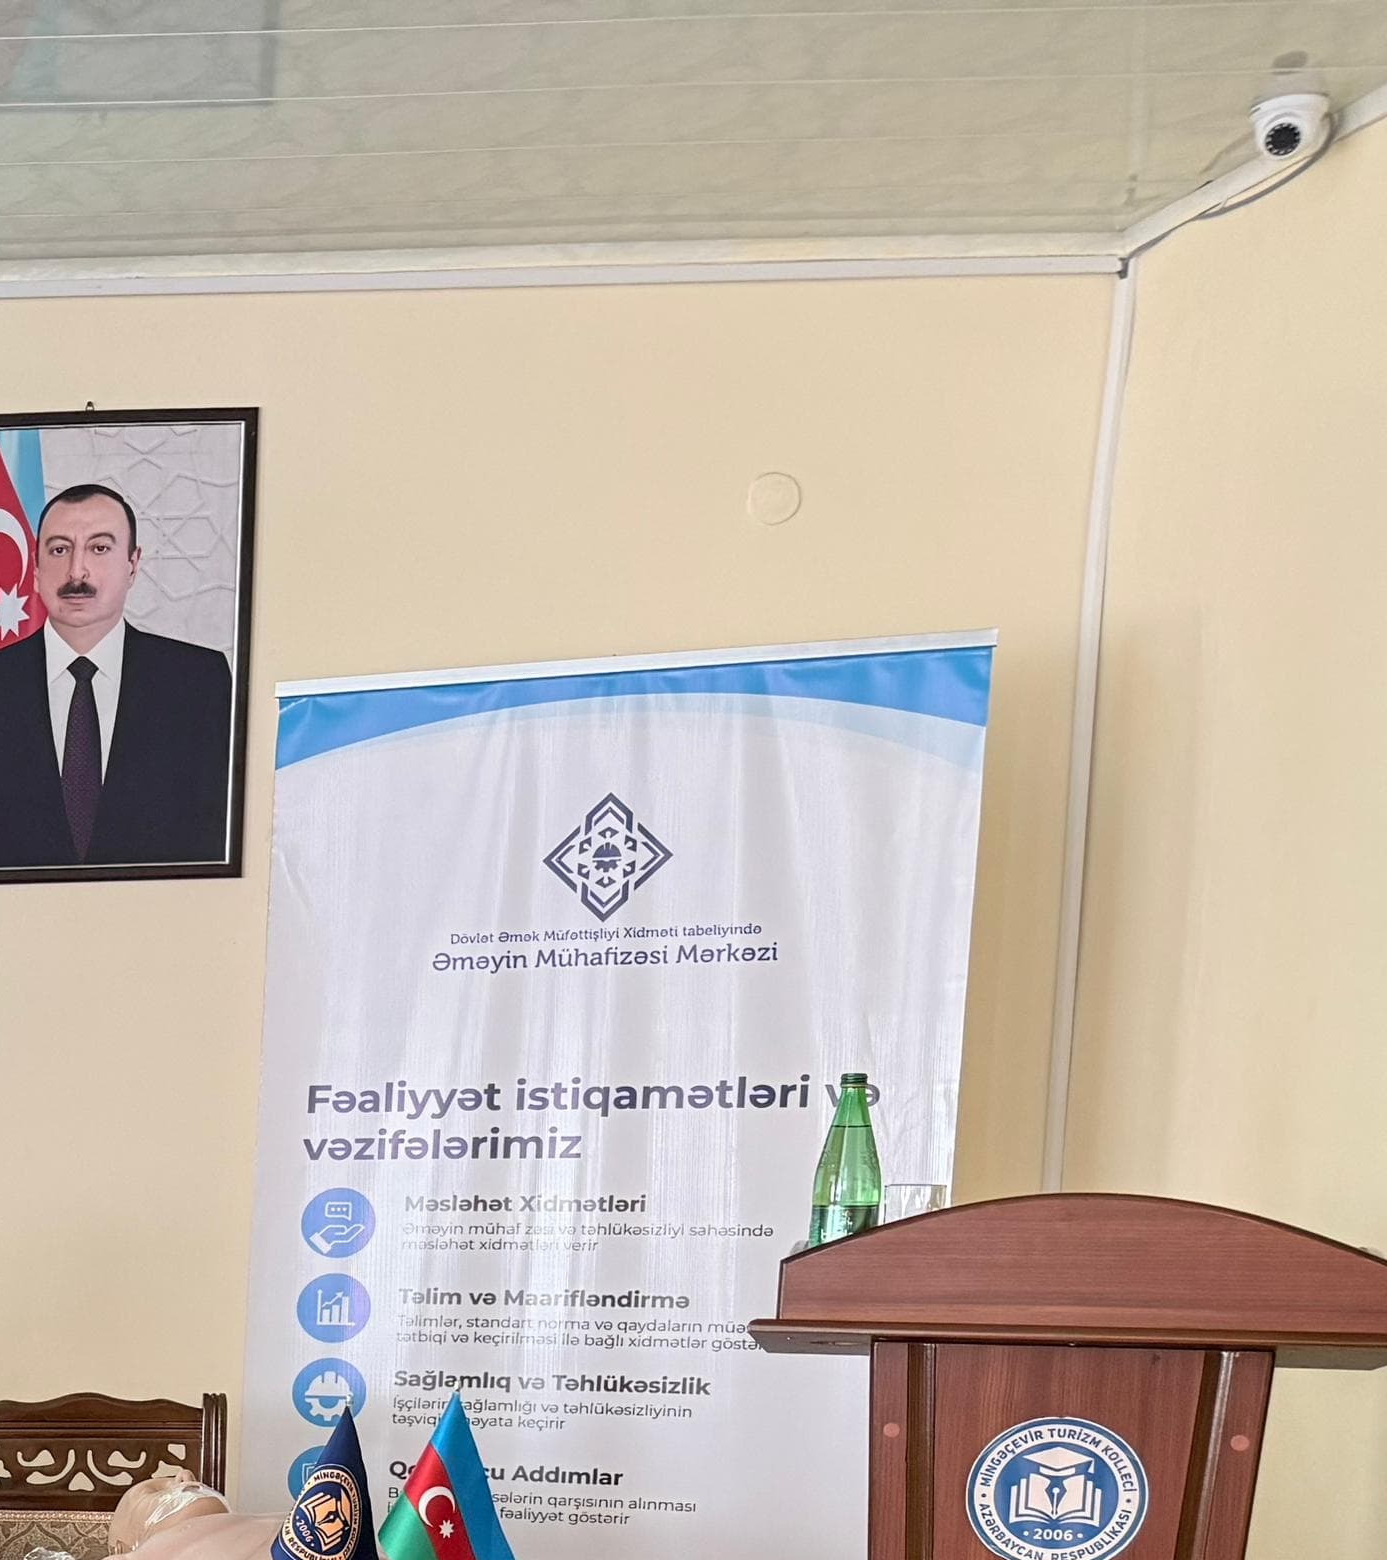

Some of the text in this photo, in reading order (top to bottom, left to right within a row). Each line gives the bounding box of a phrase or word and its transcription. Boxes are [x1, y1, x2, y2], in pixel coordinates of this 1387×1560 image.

[430, 940, 779, 977] Əməyin Mühafizəsi Mərkəzi
[305, 1077, 502, 1120] Fəaliyyət
[514, 1073, 812, 1119] istiqamətləri
[301, 1127, 583, 1162] vəzifələrimiz
[404, 1193, 646, 1212] Məsləhət Xidmətləri
[467, 1221, 554, 1235] mühafzəsi
[397, 1287, 690, 1309] Təlim və Maarifləndirmə
[593, 1320, 613, 1331] və
[449, 1334, 469, 1344] və
[393, 1370, 711, 1394] Sağlamlıq və Təhlükəsizlik
[461, 1399, 536, 1415] ağlamlığı
[540, 1403, 559, 1414] və
[1047, 1427, 1103, 1450] TURİZM
[511, 1465, 624, 1486] Addımlar
[491, 1491, 696, 1511] sələrin qarşısının alınması
[499, 1507, 630, 1527] fəaliyyət göstərir
[297, 1519, 315, 1544] 2006
[1032, 1529, 1074, 1542] 2006
